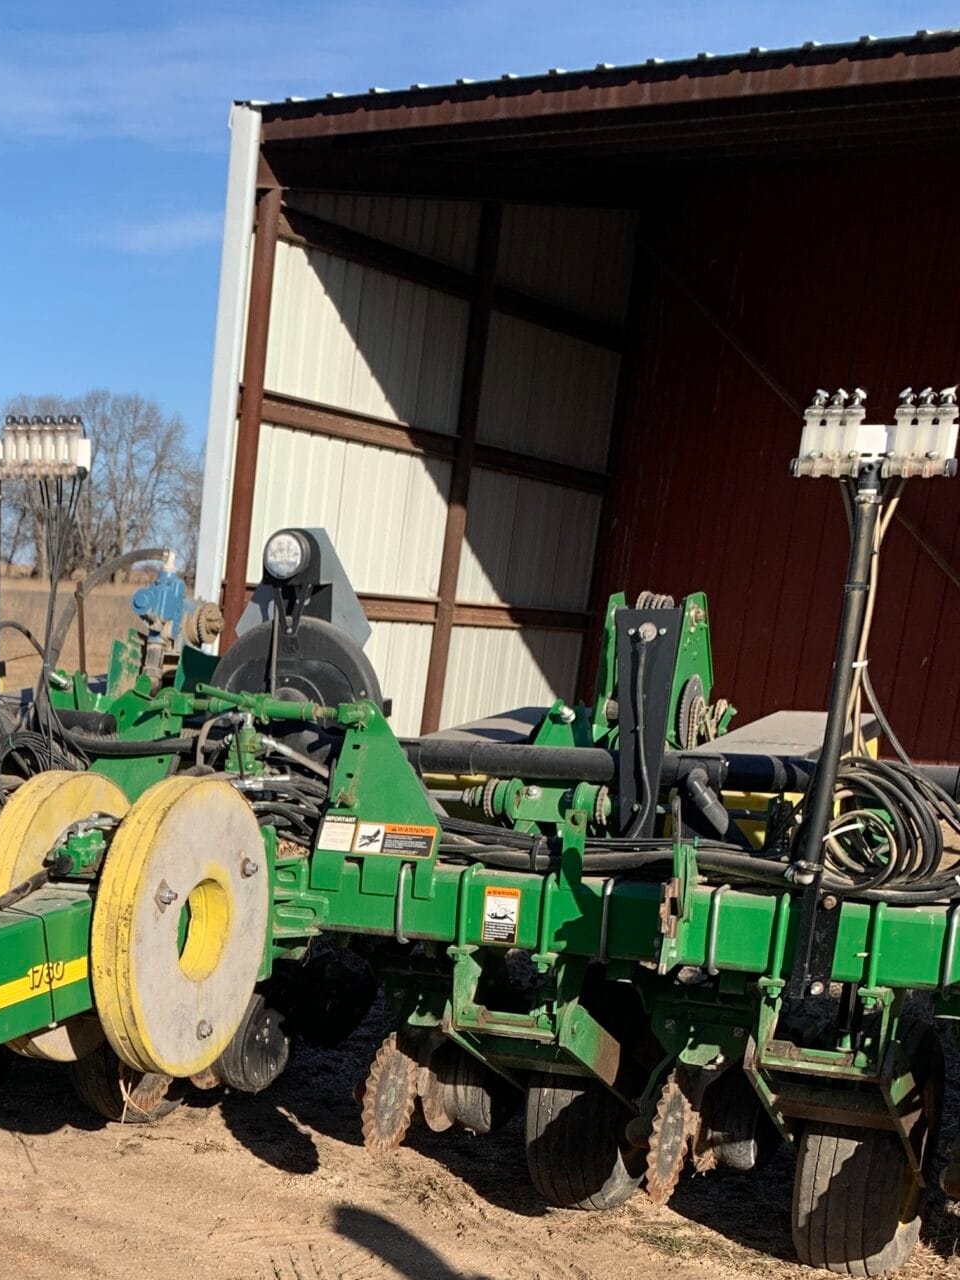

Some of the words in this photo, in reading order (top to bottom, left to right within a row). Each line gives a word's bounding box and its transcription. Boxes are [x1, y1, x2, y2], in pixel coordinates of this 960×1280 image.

[325, 814, 357, 823] IMPORTANT
[397, 826, 431, 835] WARNING
[27, 960, 66, 990] 1760
